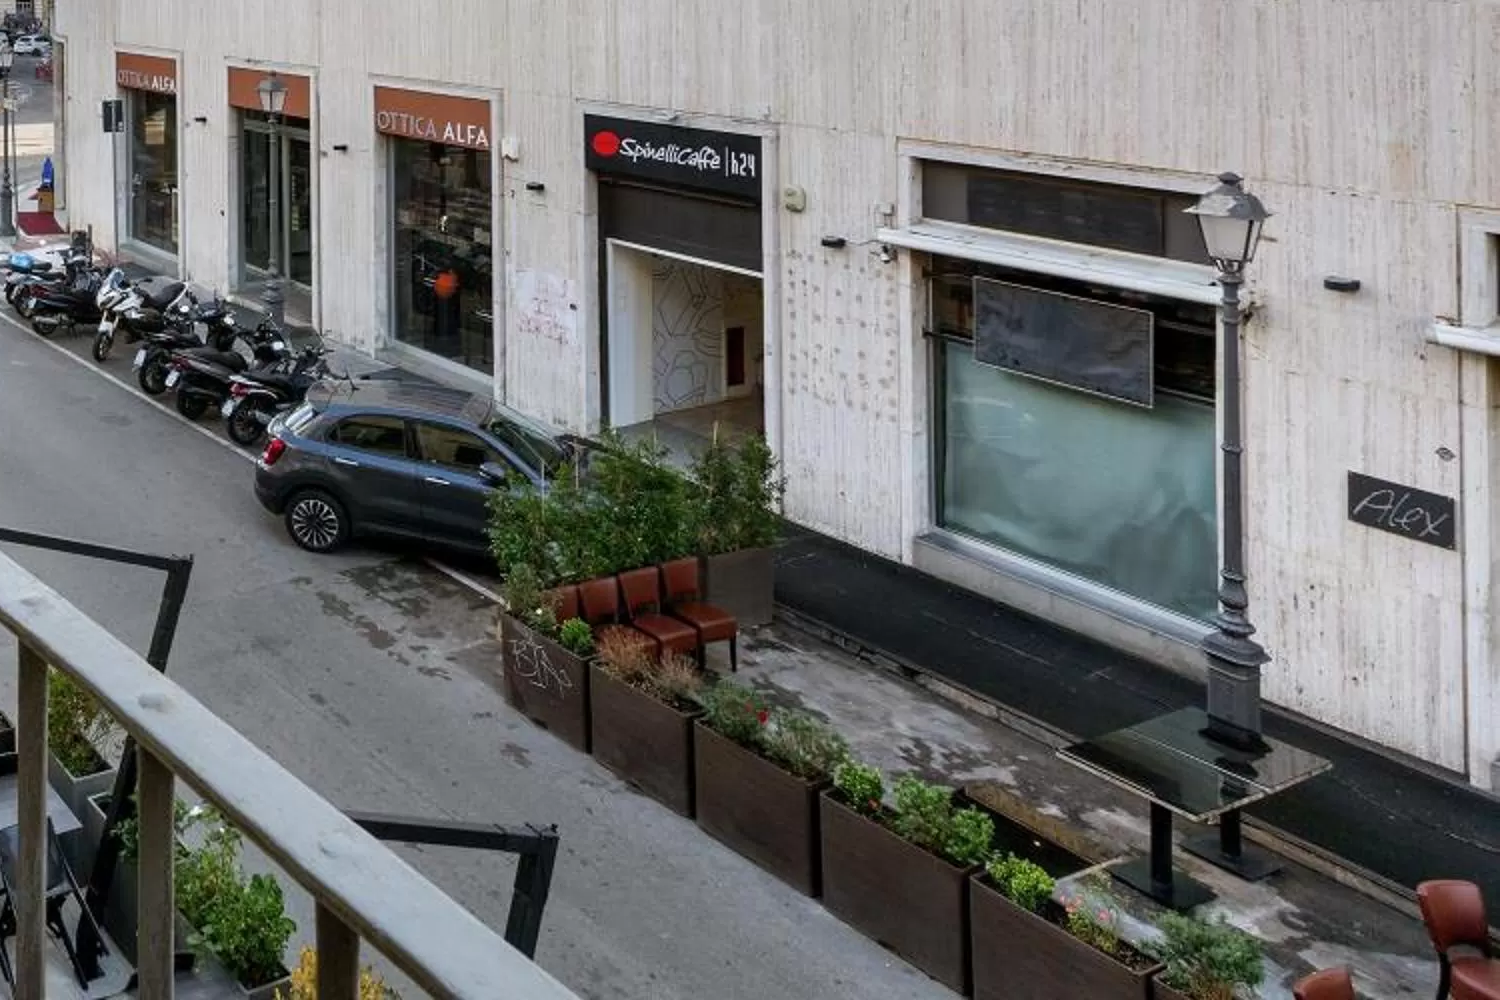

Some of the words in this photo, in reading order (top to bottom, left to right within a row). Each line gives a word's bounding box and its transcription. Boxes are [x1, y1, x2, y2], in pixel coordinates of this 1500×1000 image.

[151, 74, 179, 95] ALFA
[376, 111, 437, 138] OTTICA
[443, 121, 489, 147] ALFA
[1352, 488, 1450, 538] Alex
